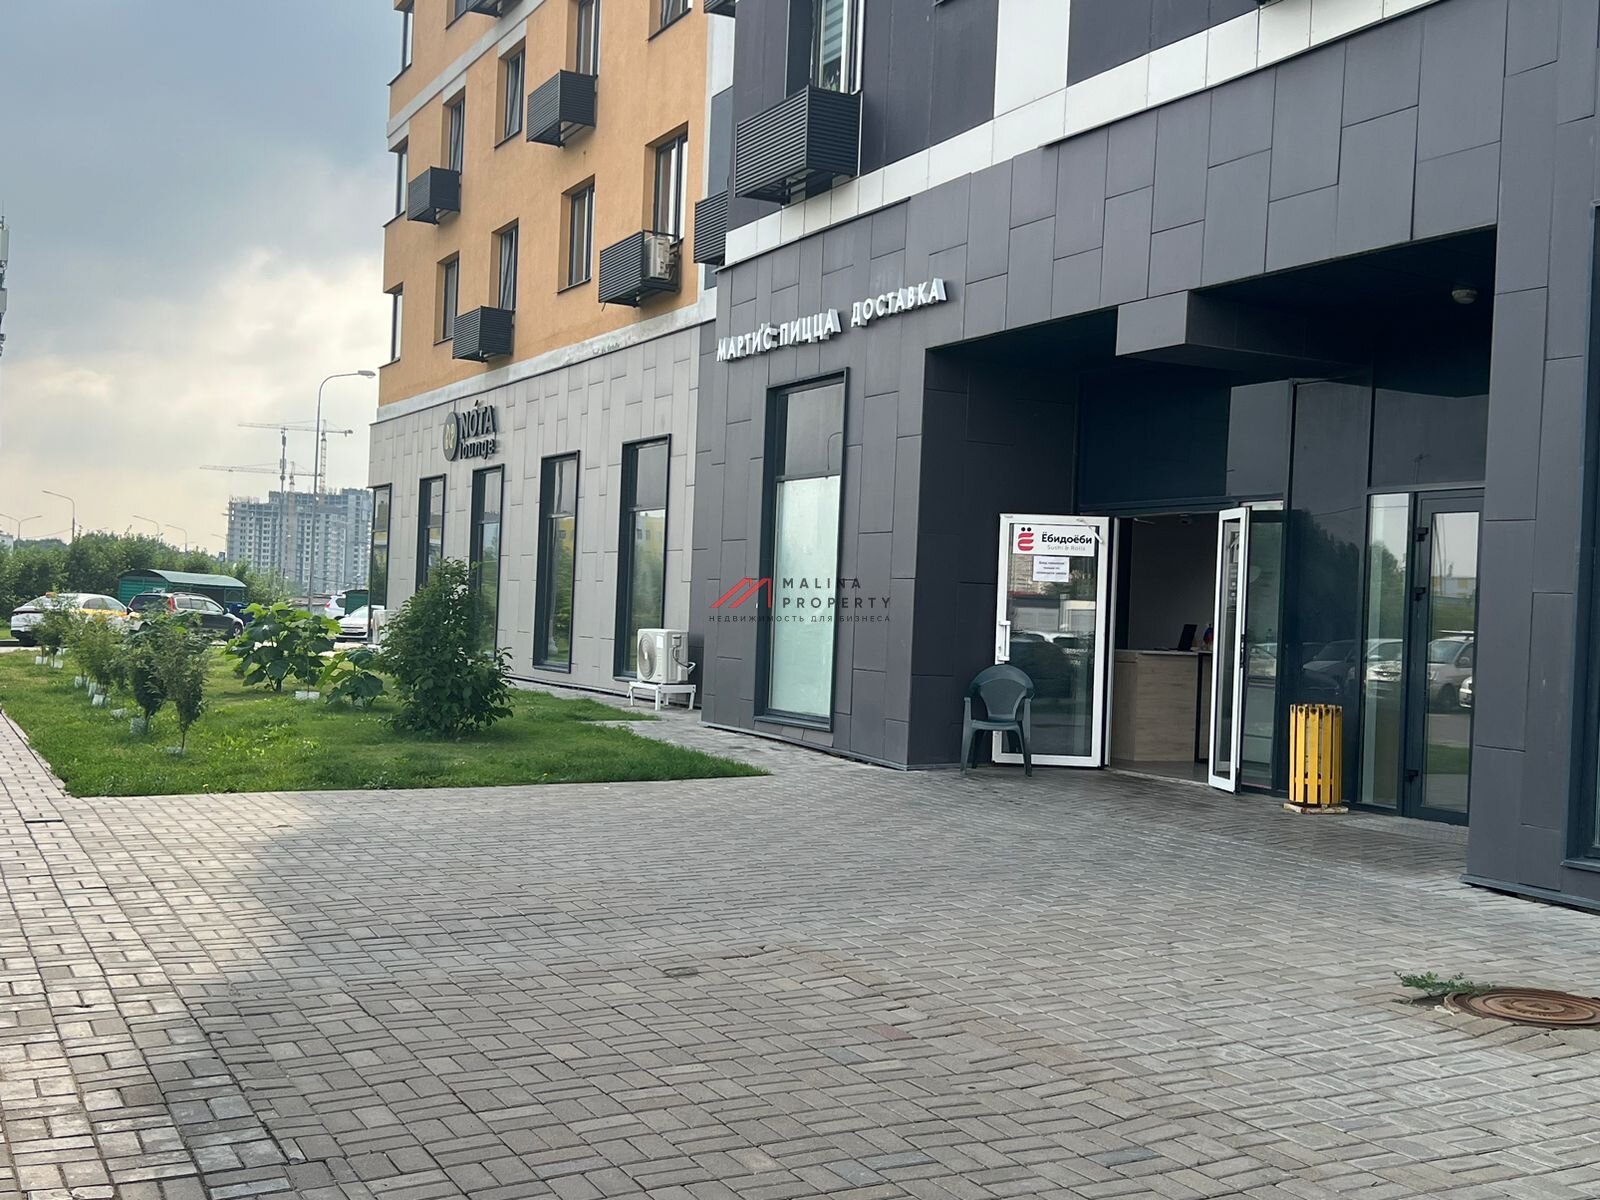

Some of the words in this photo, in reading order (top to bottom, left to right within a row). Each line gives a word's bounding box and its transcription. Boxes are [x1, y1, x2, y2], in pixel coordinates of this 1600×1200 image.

[779, 308, 842, 346] ПИЦЦА
[851, 278, 947, 328] ДОСТАВКА
[459, 439, 496, 459] lounge
[1041, 531, 1092, 544] Ёбидоёби
